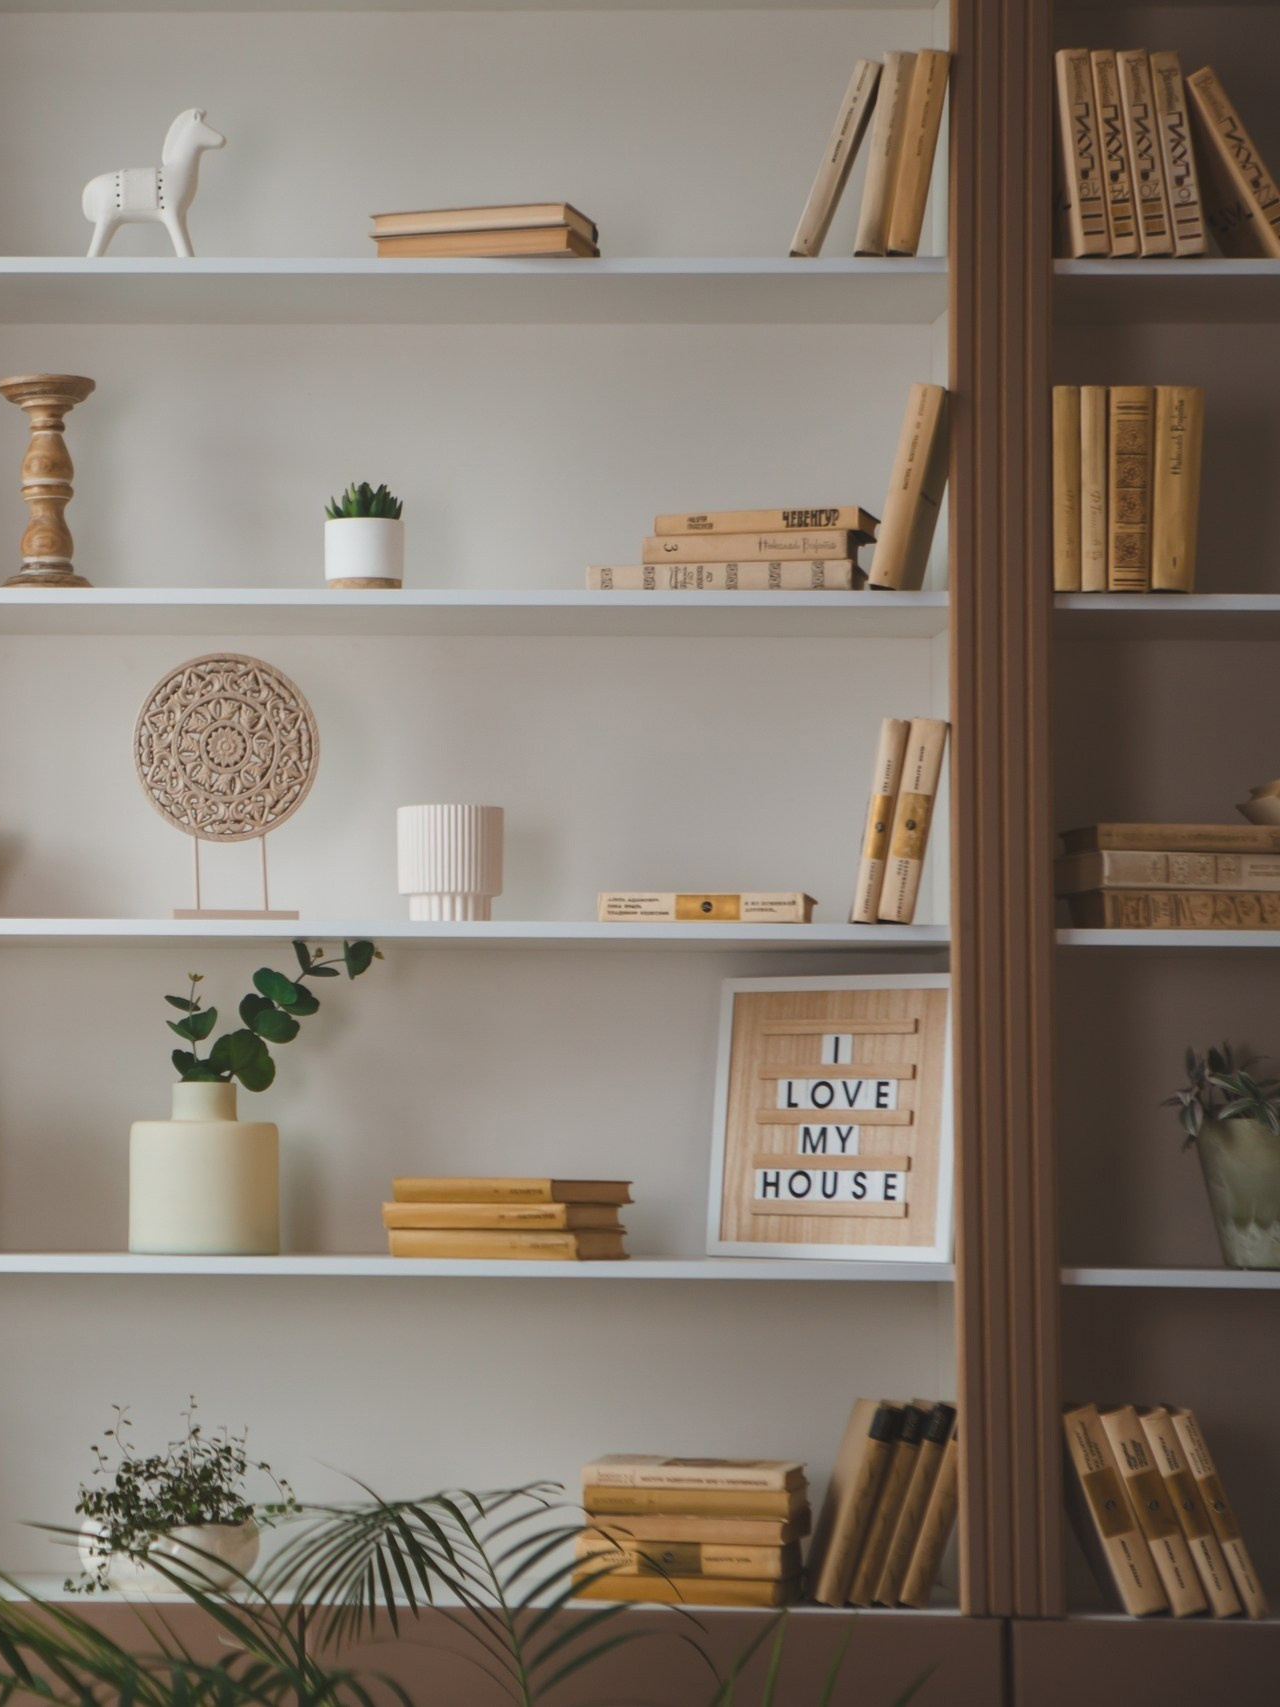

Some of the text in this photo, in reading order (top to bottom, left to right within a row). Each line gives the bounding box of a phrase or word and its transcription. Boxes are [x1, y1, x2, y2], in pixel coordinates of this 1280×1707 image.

[782, 508, 840, 528] ЧЕВЕНГУР
[663, 543, 678, 552] 3
[833, 1036, 840, 1064] I
[786, 1080, 890, 1109] LOVE
[801, 1126, 855, 1154] MY
[762, 1170, 898, 1201] HOUSE
